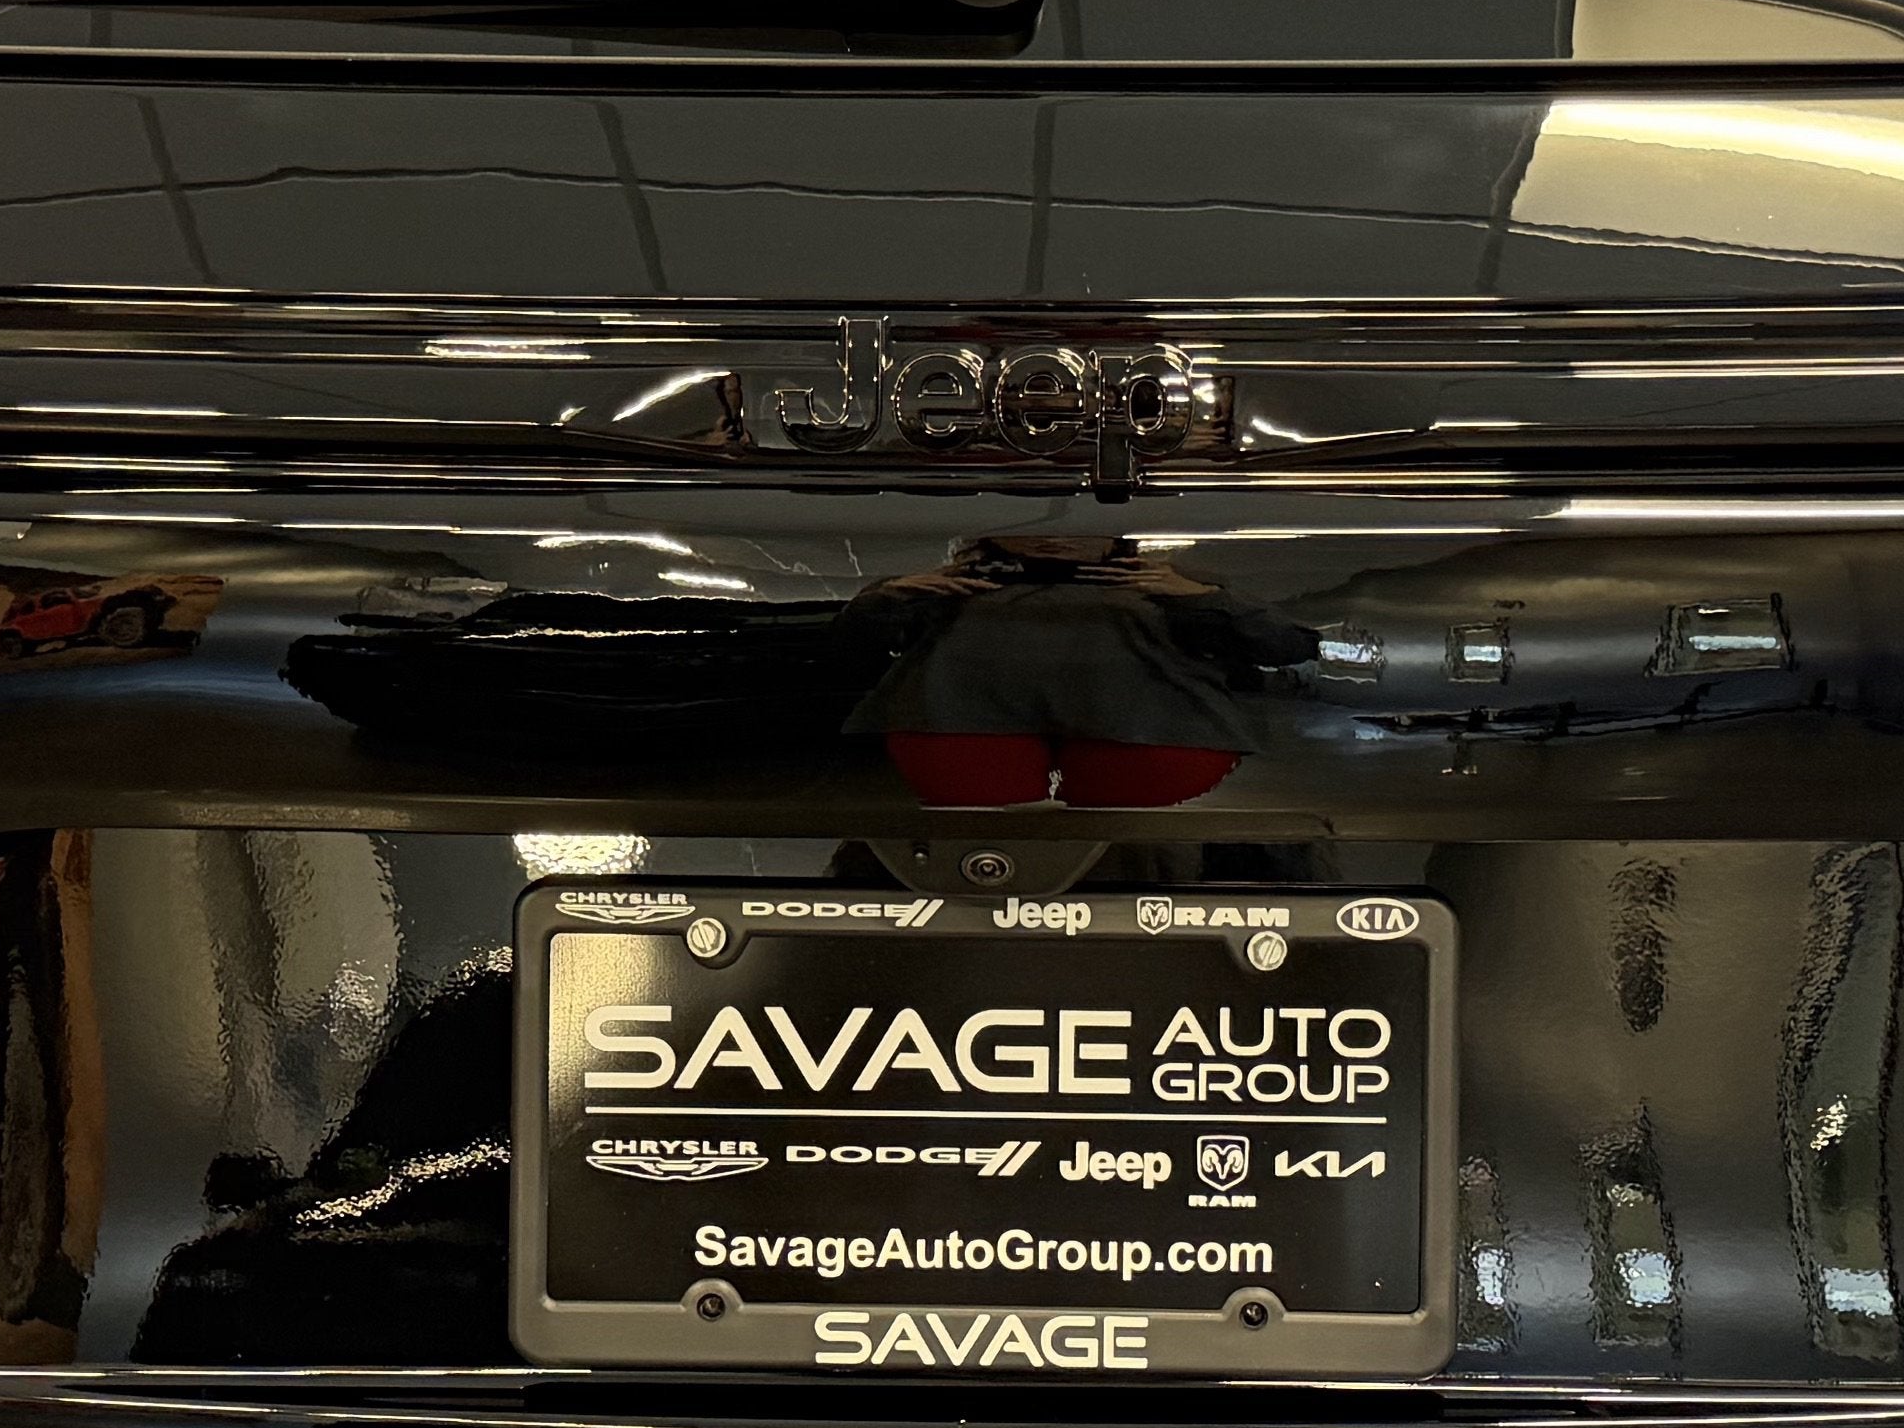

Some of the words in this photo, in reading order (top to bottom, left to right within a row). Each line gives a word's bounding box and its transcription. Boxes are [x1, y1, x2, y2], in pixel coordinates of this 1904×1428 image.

[777, 316, 1193, 486] Jeep
[560, 891, 688, 906] CHRYSLER
[742, 900, 918, 921] DODGE
[993, 897, 1091, 935] Jeep
[1173, 907, 1290, 928] RAM
[1351, 907, 1407, 930] KIA
[584, 1005, 1132, 1095] SAVAGE
[1153, 1006, 1391, 1058] AUTO
[1152, 1063, 1390, 1104] GROUP
[592, 1139, 759, 1156] CHRYSLER
[786, 1143, 1008, 1167] DODGE
[1060, 1141, 1171, 1189] Jeep
[1188, 1194, 1257, 1208] RAM
[694, 1225, 1273, 1280] SavageAutoGroup.com
[815, 1311, 1149, 1370] SAVAGE
